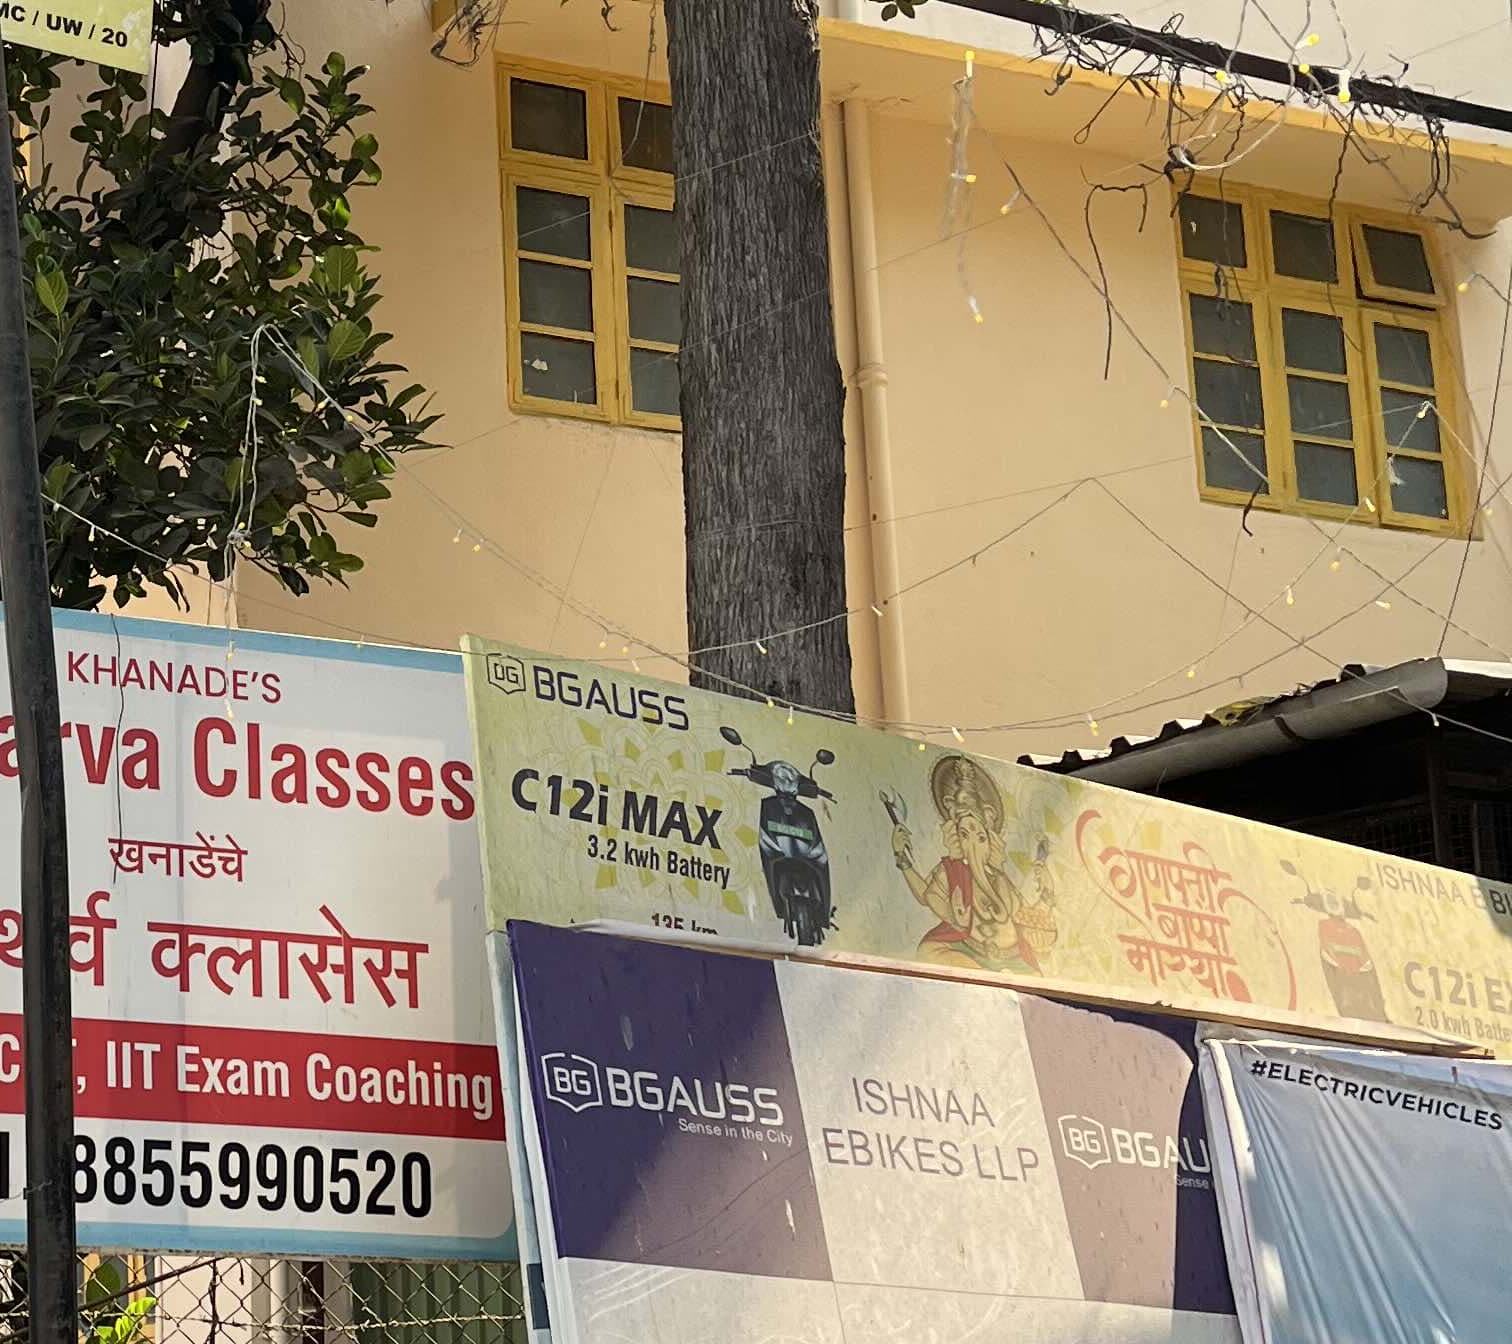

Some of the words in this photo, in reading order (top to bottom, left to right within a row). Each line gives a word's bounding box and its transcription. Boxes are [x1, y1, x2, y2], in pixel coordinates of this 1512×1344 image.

[46, 15, 84, 37] UW
[101, 27, 129, 49] 20
[532, 664, 690, 732] BGAUSS
[193, 716, 476, 822] Classes
[511, 768, 610, 827] C12i
[621, 790, 725, 851] MAX
[108, 831, 249, 884] खनाडेंचे
[586, 833, 618, 864] 3.2
[623, 839, 660, 873] kwh
[666, 848, 731, 892] Battery
[1375, 862, 1465, 905] ISHNAA
[146, 903, 431, 1010] क्लासेस
[1404, 960, 1478, 1009] C12i
[1415, 1006, 1439, 1030] 2.0
[1441, 1014, 1472, 1039] kwh
[105, 1039, 161, 1090] IIT
[176, 1044, 291, 1099] Exam
[304, 1052, 494, 1122] Coaching
[553, 1068, 593, 1098] BG
[605, 1065, 785, 1127] BGAUSS
[852, 1076, 996, 1130] ISHNAA
[1251, 1058, 1504, 1131] #ELECTRICVEHICLES
[678, 1116, 721, 1140] Sense
[725, 1125, 739, 1140] in
[742, 1126, 764, 1144] the
[766, 1129, 794, 1148] City
[822, 1127, 968, 1177] EBIKES
[976, 1141, 1040, 1184] LLP
[1067, 1125, 1102, 1156] BG
[72, 1133, 433, 1219] 8855990520
